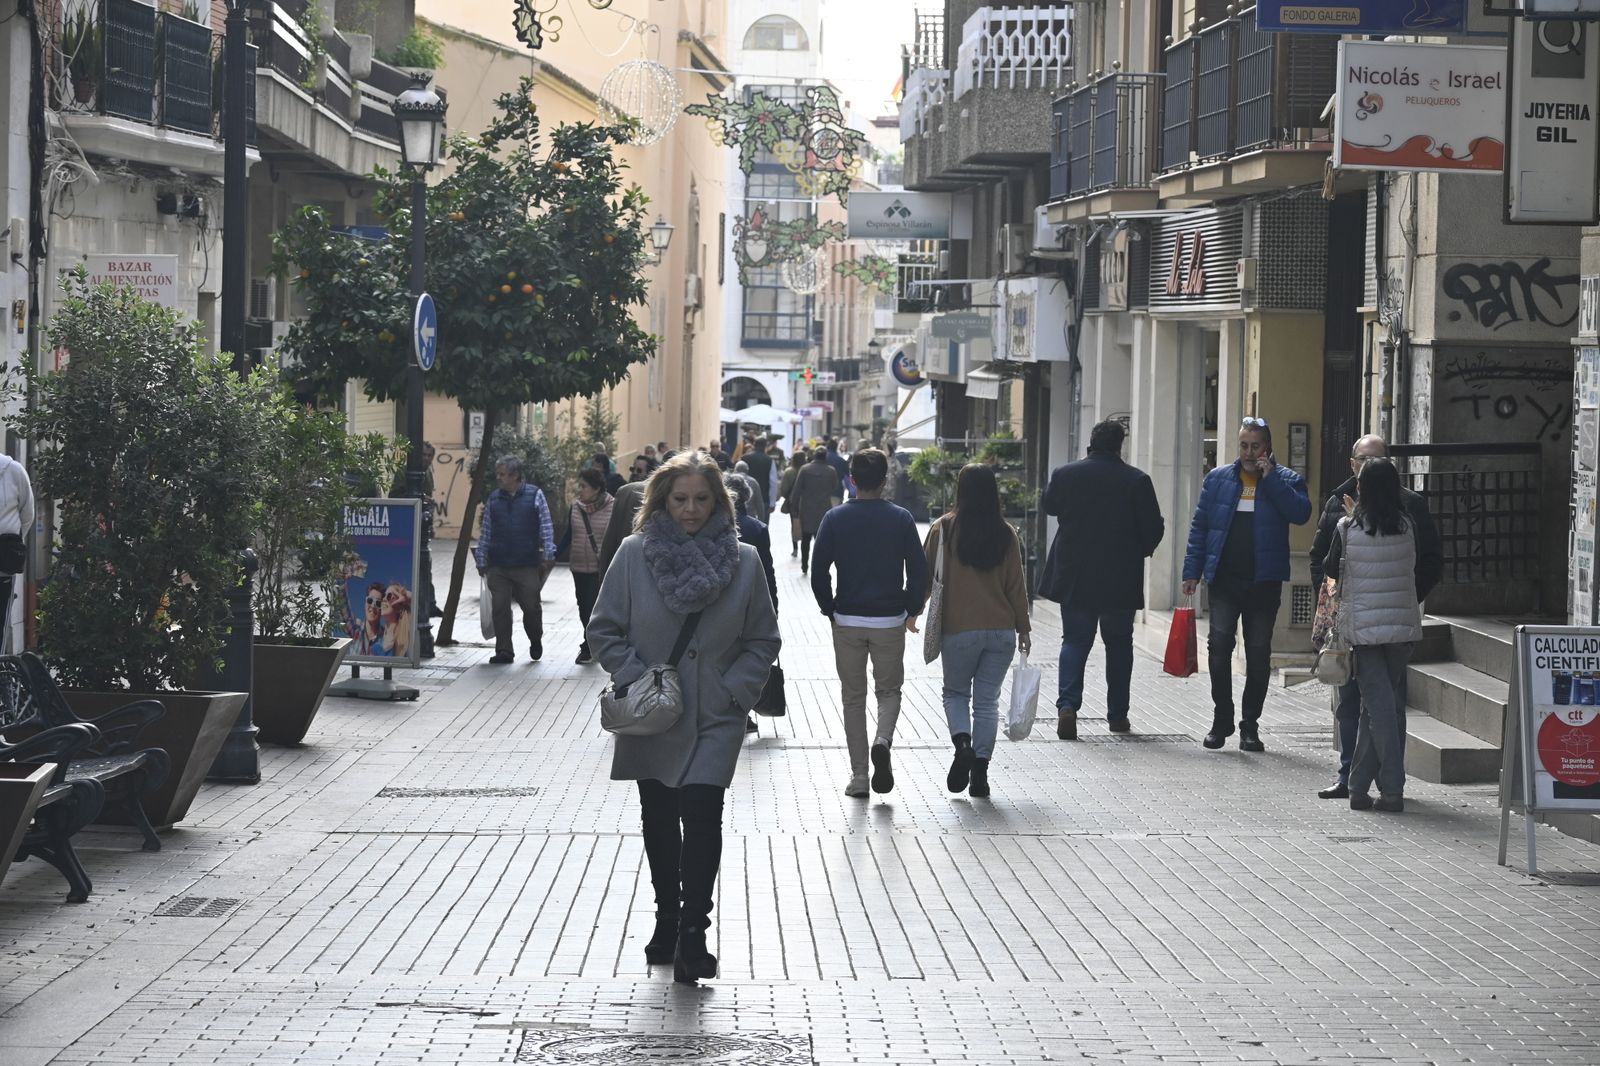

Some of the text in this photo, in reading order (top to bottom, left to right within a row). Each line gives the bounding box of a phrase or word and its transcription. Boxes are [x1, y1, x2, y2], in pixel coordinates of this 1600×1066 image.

[1283, 9, 1357, 22] FONDO GALERIA
[1349, 65, 1420, 86] Nicolás
[1448, 70, 1502, 89] Israel
[1405, 96, 1461, 107] PELUQUEROS
[1524, 102, 1590, 121] JOYERIA
[1536, 126, 1577, 143] GIL
[108, 262, 152, 272] BAZAR
[90, 273, 172, 286] ALIMENTACIÓN
[1534, 637, 1600, 654] CALCULAD
[1535, 655, 1600, 670] CIENTIFI
[1568, 710, 1583, 720] ctt
